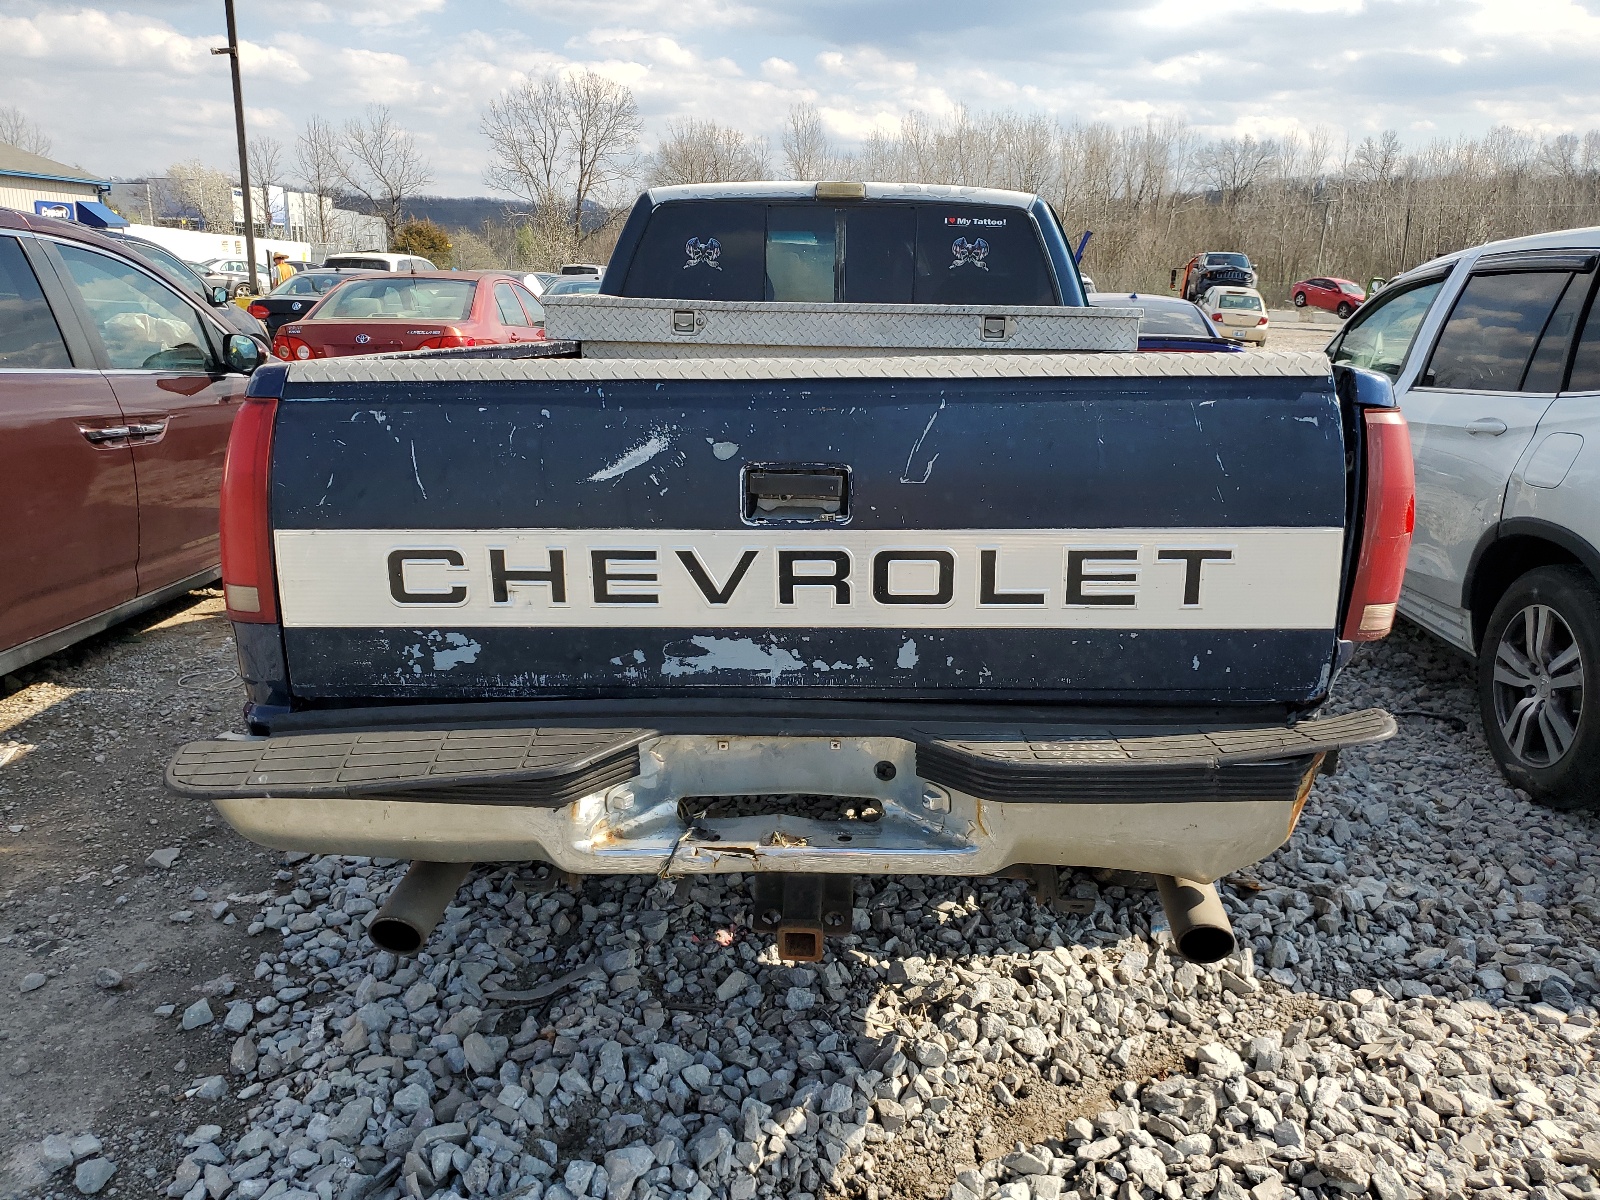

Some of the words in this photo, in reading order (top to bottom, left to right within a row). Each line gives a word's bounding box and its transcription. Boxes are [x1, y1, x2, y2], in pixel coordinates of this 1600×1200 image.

[957, 217, 971, 226] My
[972, 218, 1007, 226] Tattoo!
[386, 547, 1235, 607] CHEVROLET
